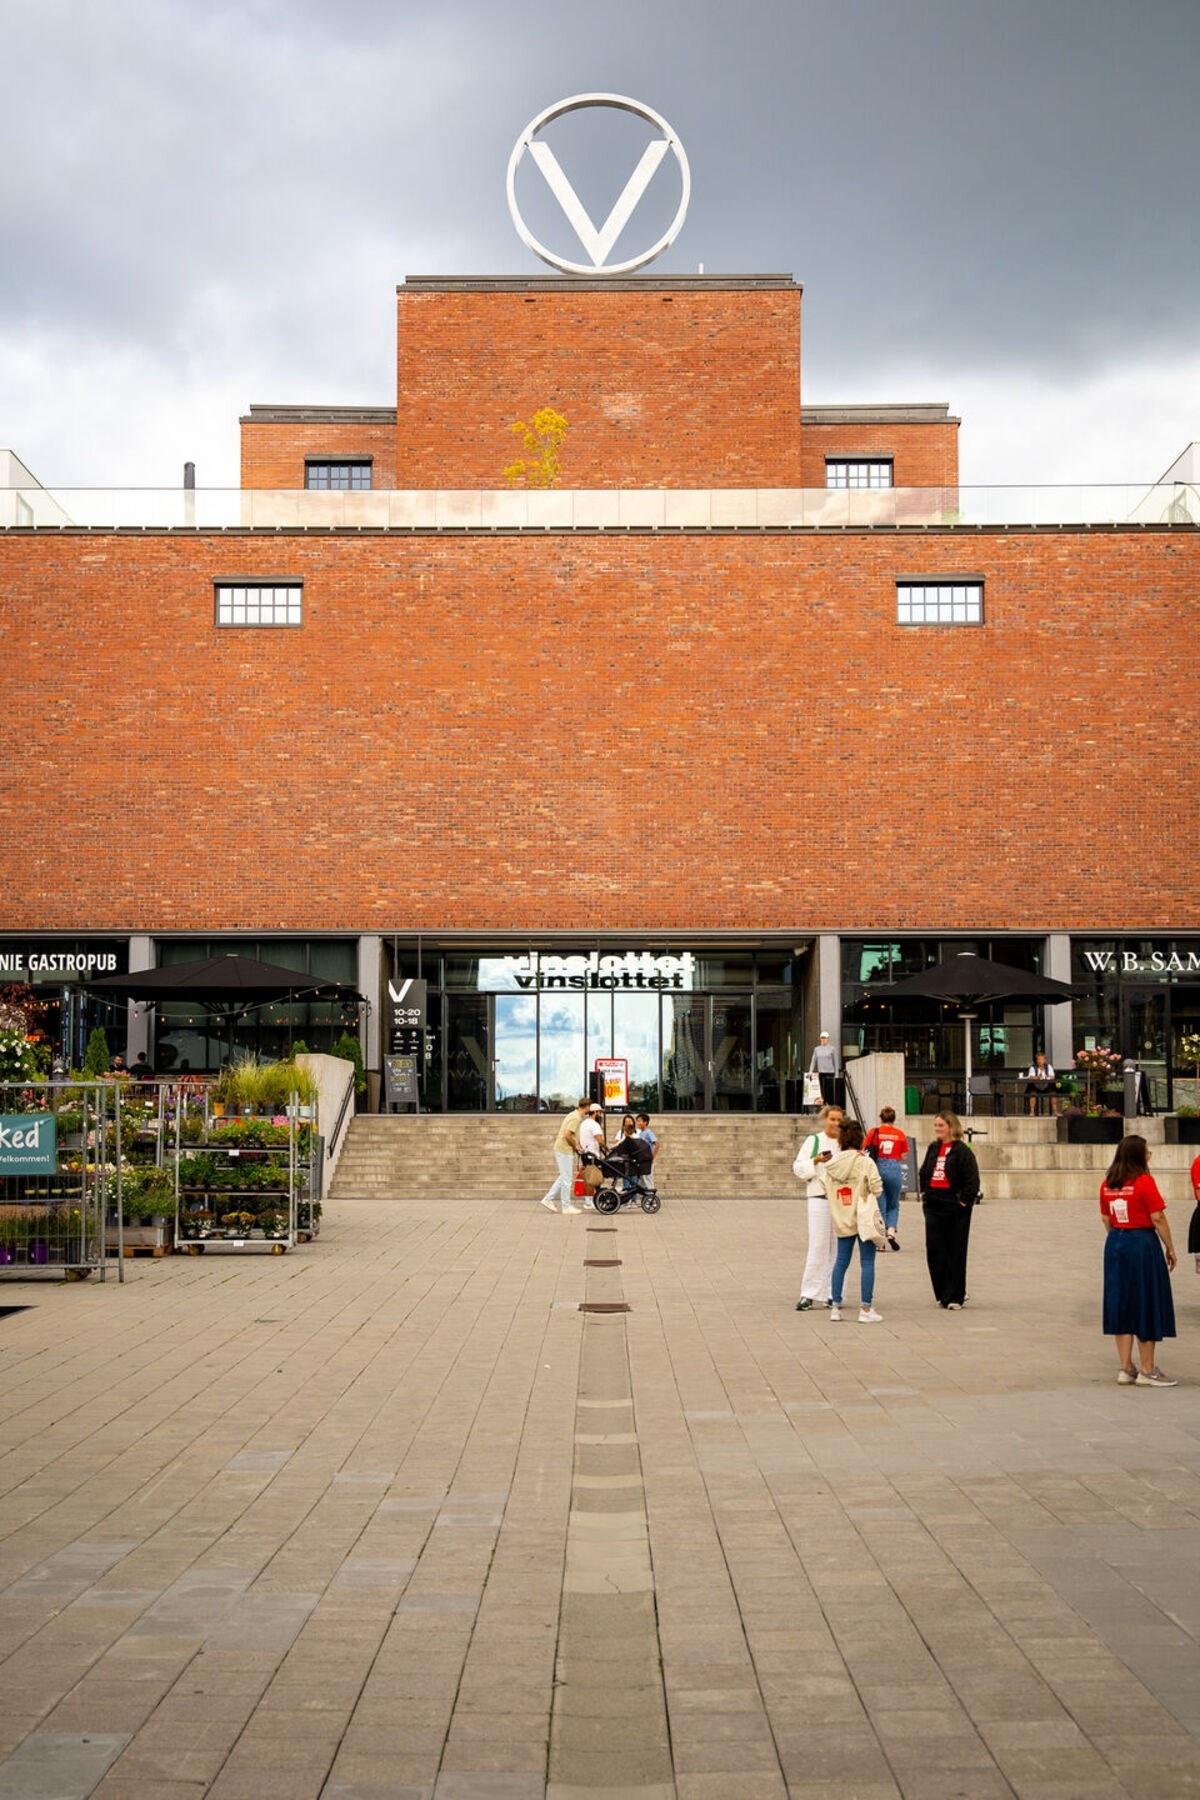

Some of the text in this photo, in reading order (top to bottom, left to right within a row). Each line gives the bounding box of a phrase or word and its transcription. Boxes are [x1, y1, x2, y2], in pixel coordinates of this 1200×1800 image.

[525, 140, 669, 268] V
[28, 953, 117, 971] GASTROPUB
[1084, 951, 1116, 971] W.
[1122, 951, 1145, 971] B.
[514, 971, 684, 990] vinslottet
[388, 978, 414, 1003] V
[394, 1008, 421, 1016] 10-20
[394, 1017, 419, 1025] 10-18
